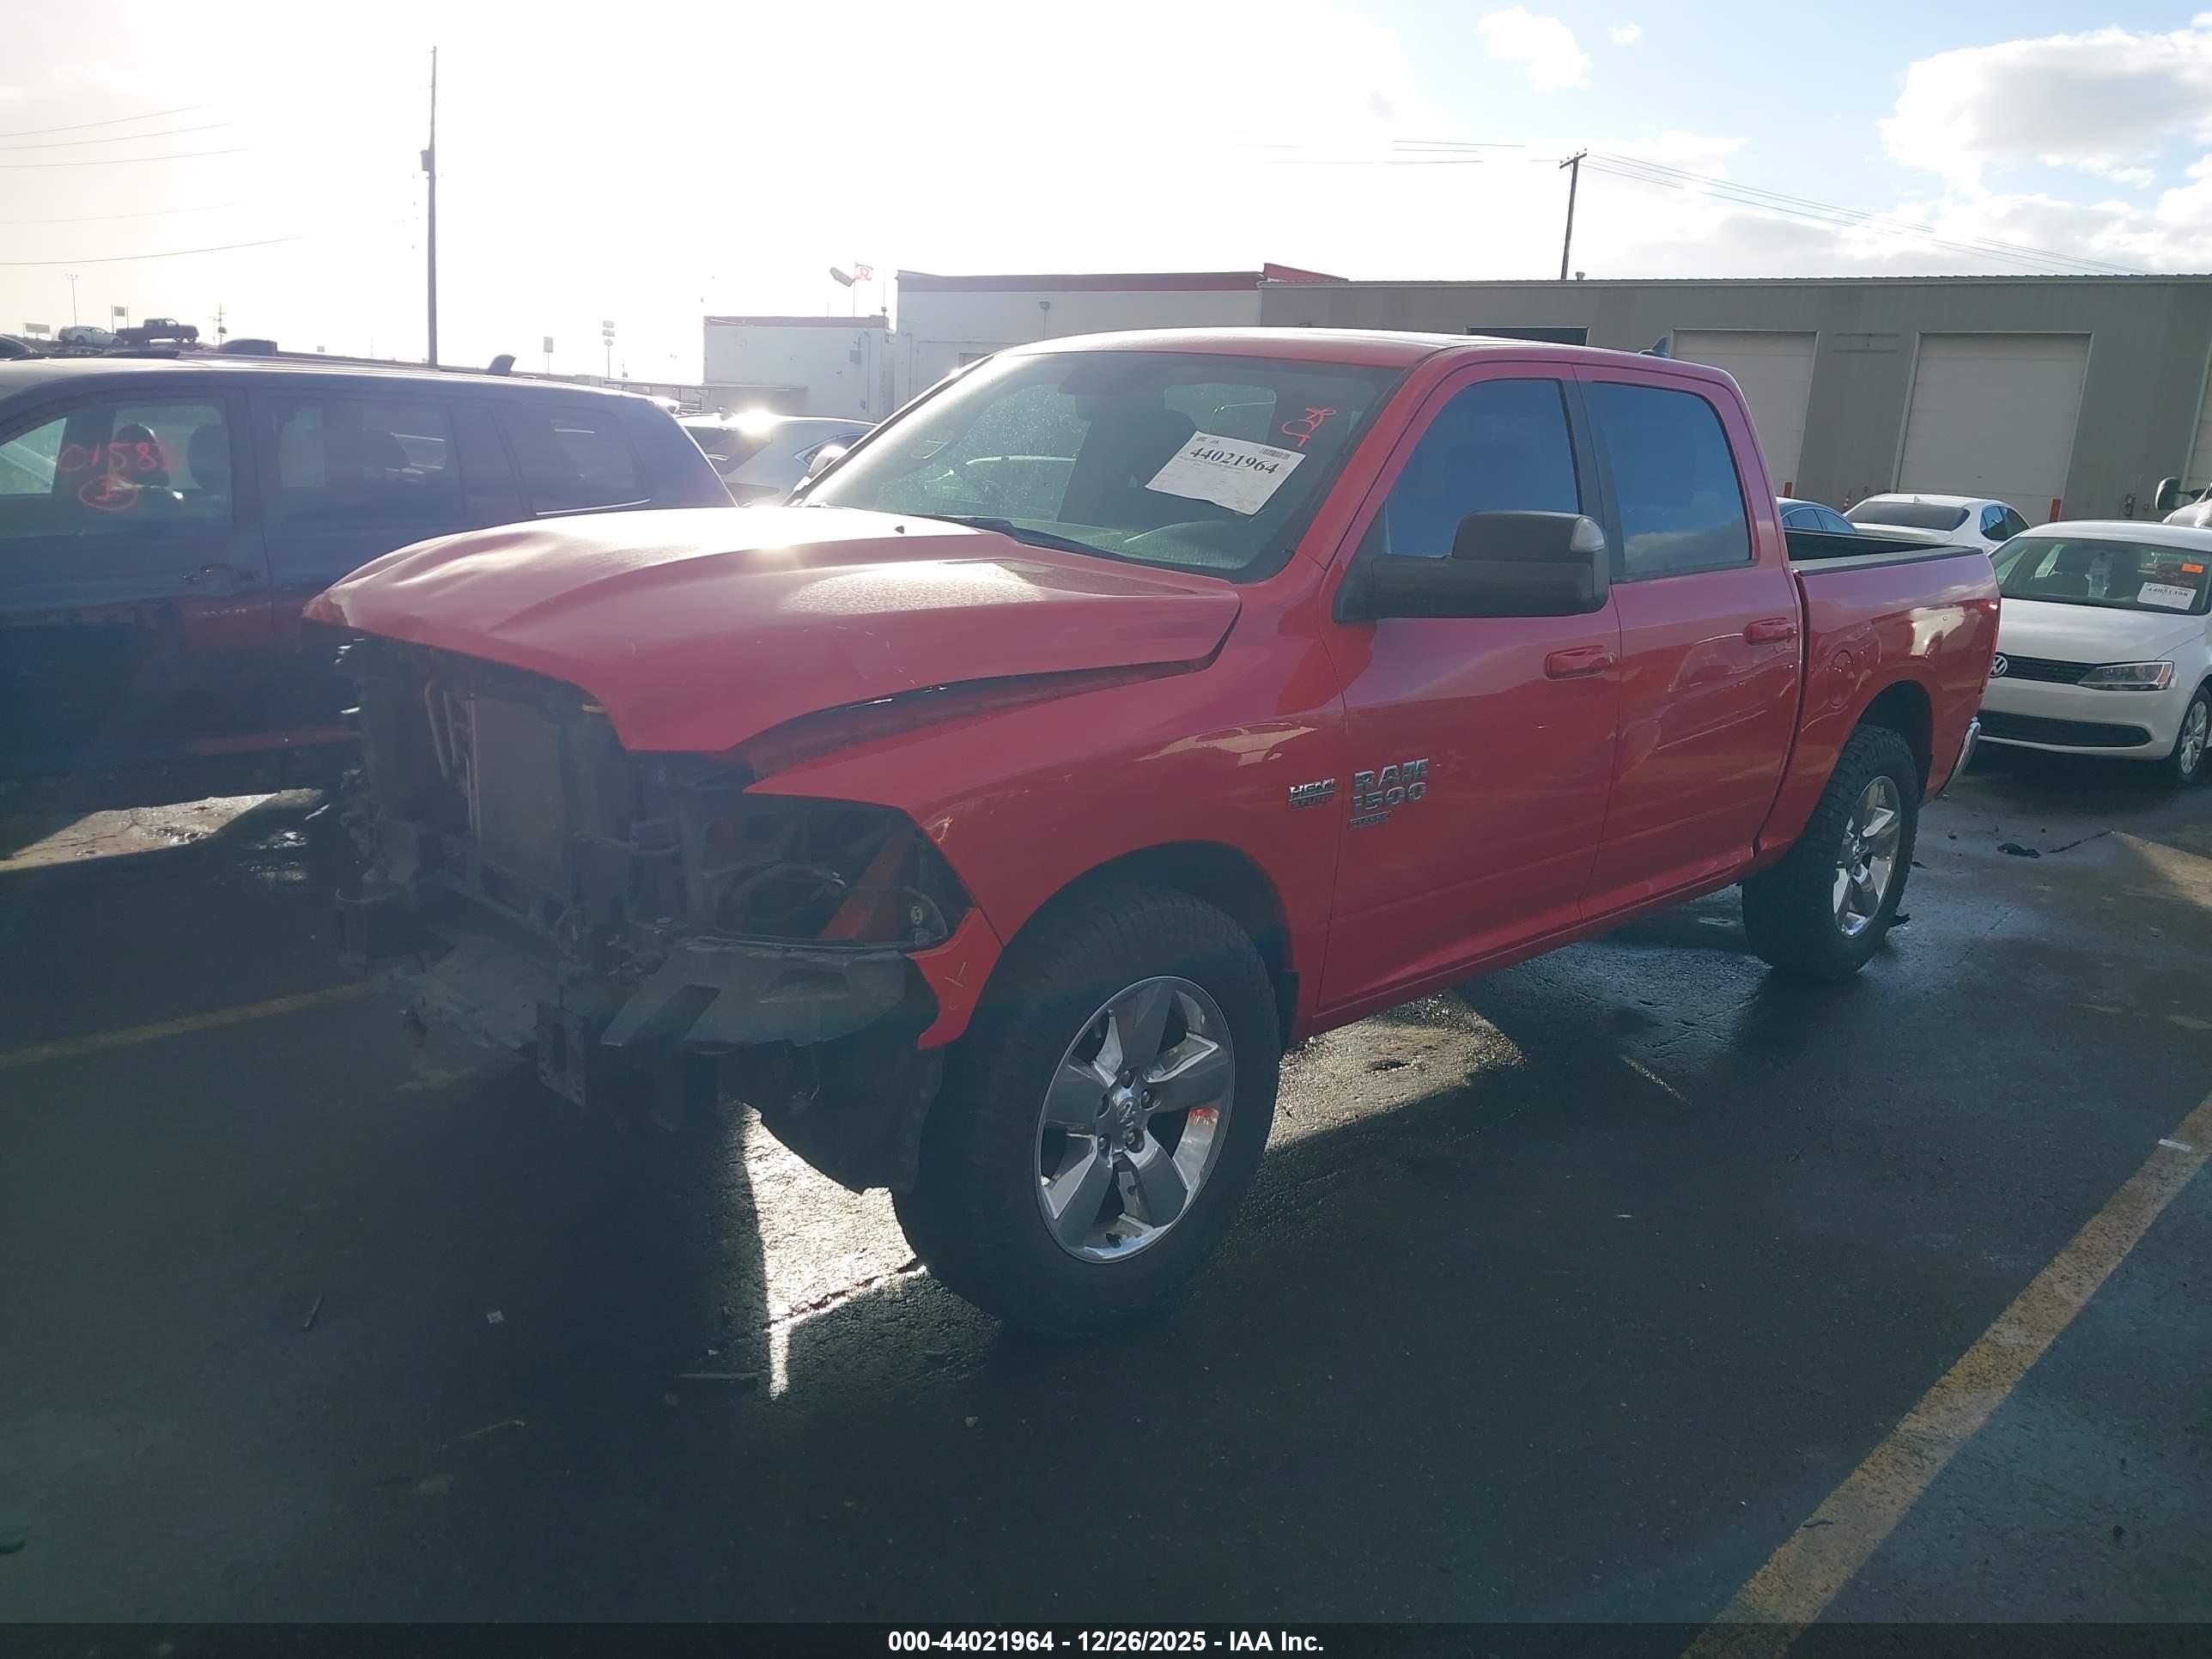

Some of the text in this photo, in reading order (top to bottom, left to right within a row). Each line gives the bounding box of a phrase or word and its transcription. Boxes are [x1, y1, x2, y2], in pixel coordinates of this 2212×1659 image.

[1190, 447, 1280, 474] 44021964
[1290, 778, 1335, 799] HEMI
[1354, 757, 1429, 792] RAM
[1353, 781, 1427, 816] 1500
